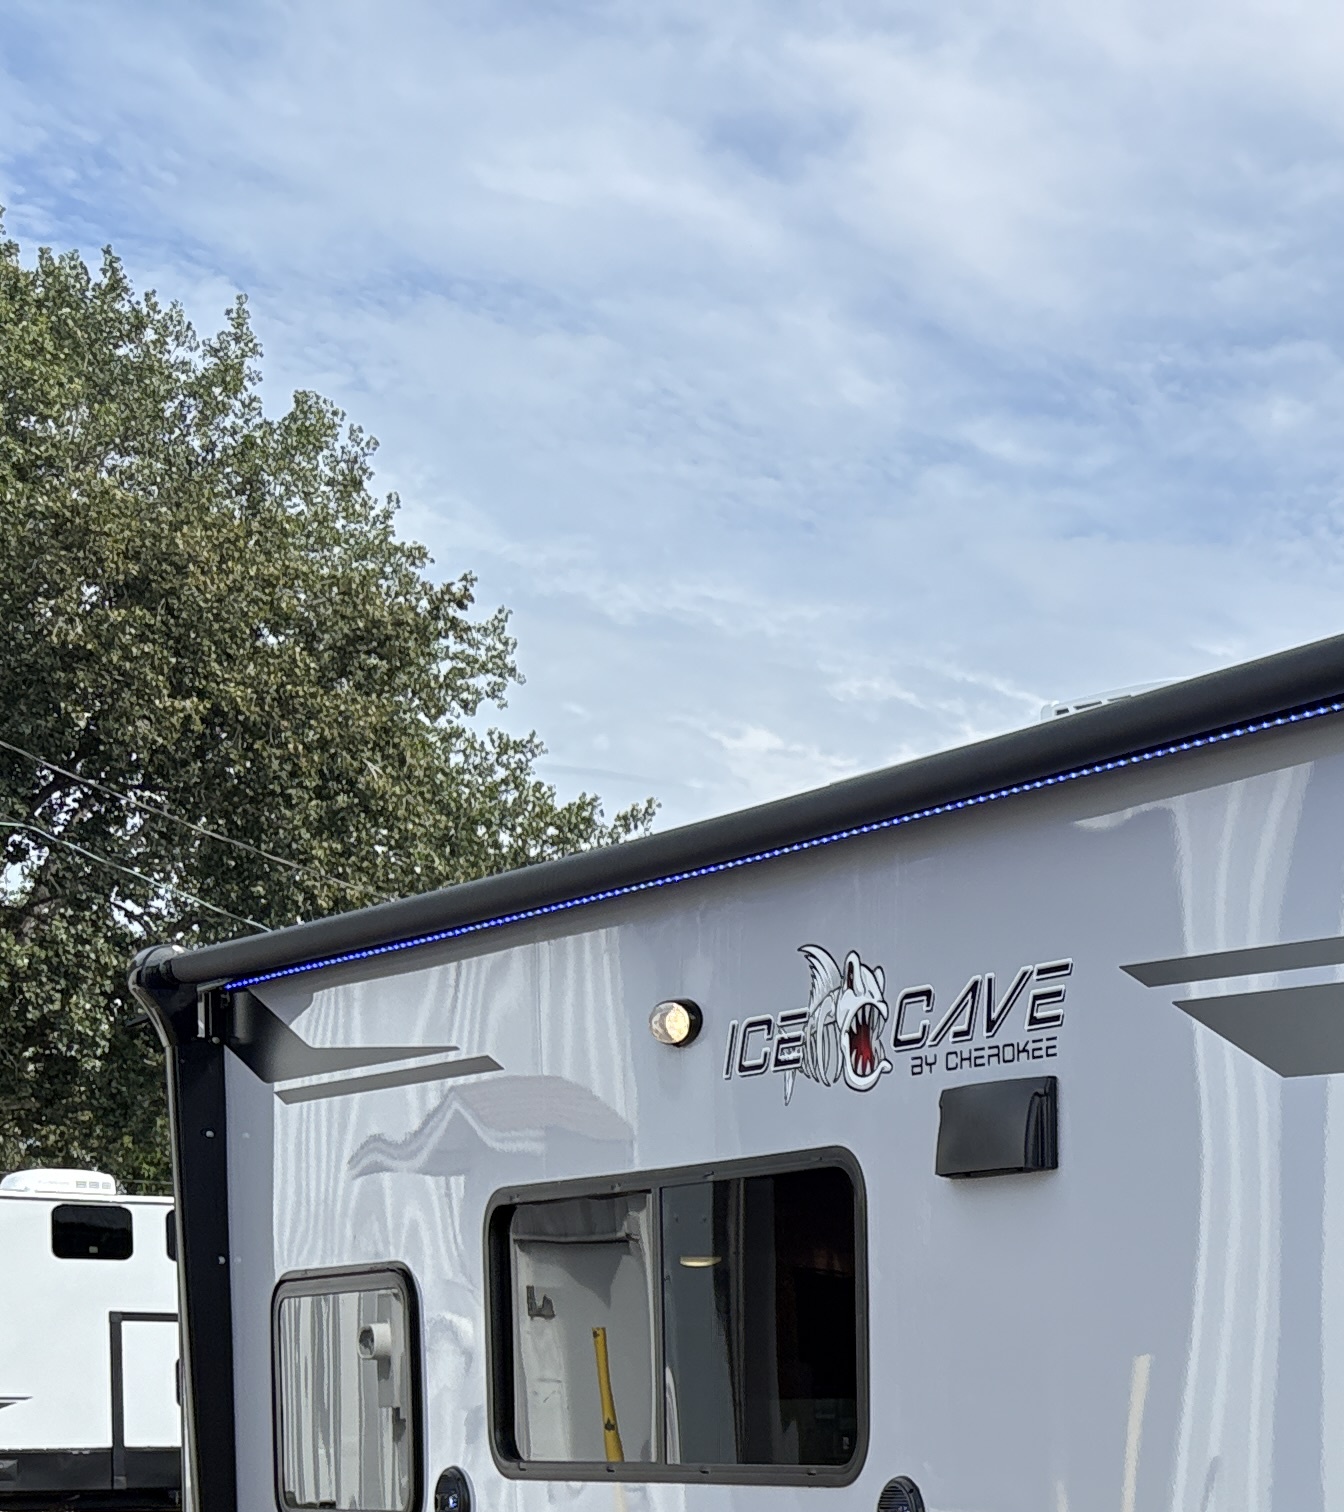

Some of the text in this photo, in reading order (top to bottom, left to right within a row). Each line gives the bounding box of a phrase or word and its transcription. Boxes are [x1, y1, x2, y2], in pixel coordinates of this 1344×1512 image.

[722, 958, 1074, 1080] ICE CAVE
[910, 1035, 1059, 1077] BY CHEROKEE
